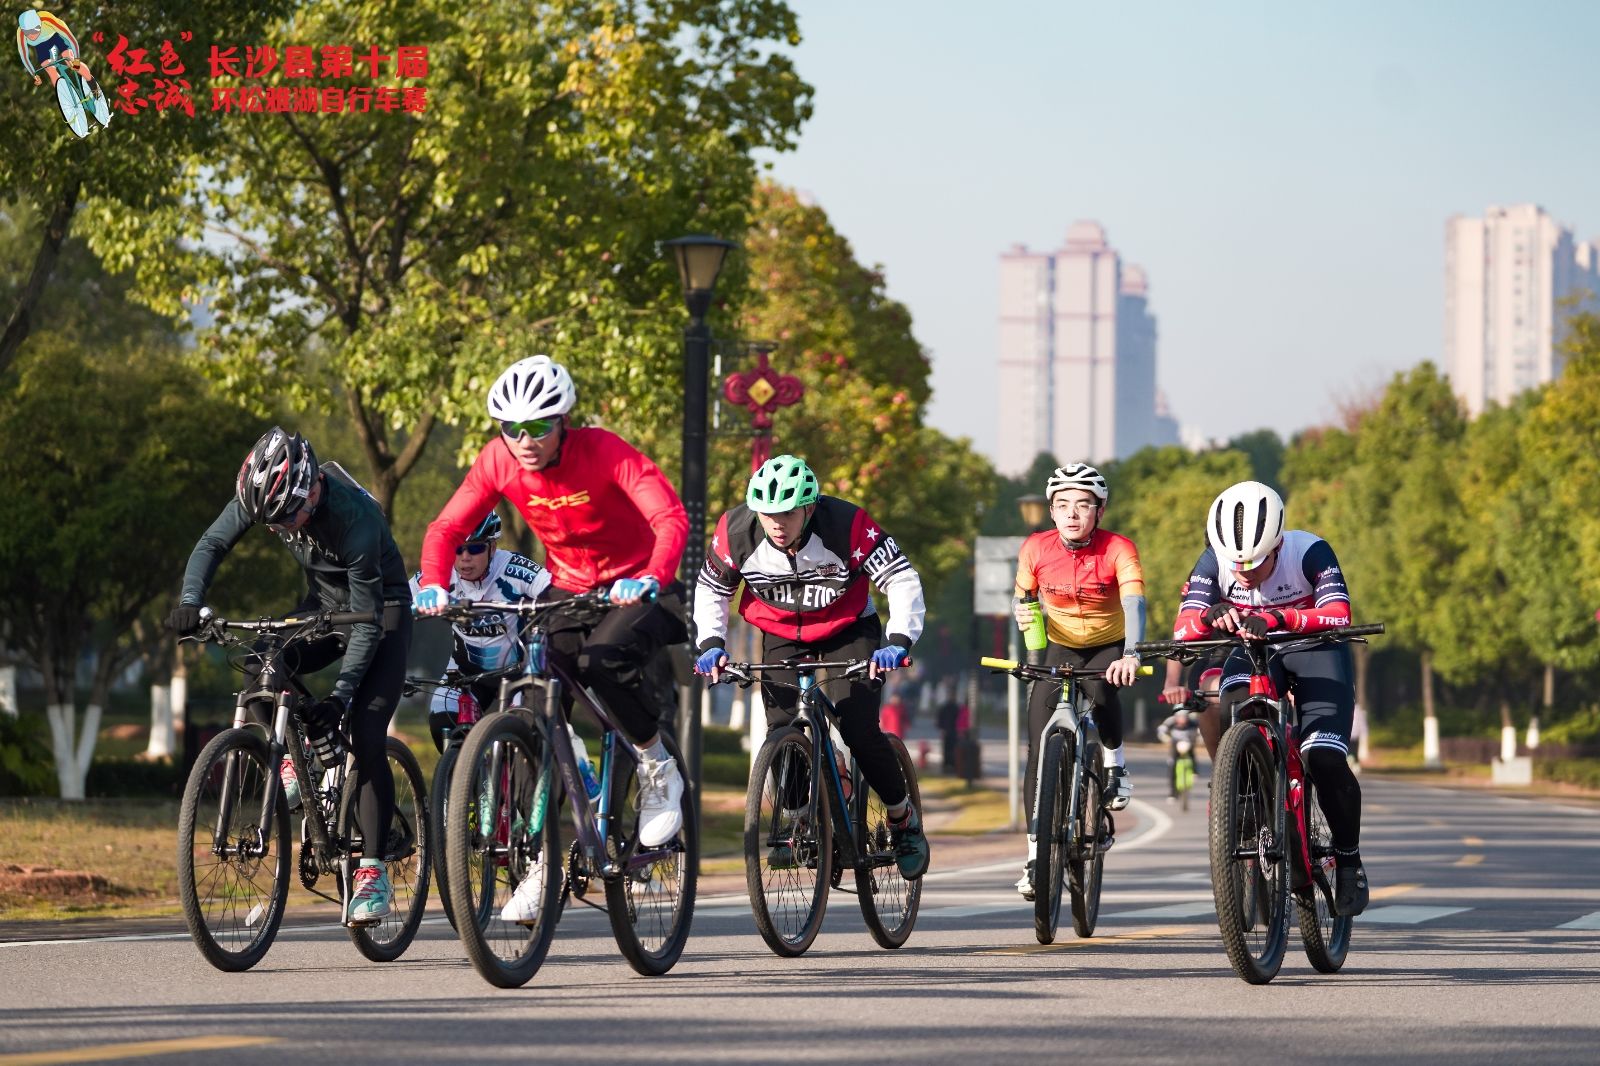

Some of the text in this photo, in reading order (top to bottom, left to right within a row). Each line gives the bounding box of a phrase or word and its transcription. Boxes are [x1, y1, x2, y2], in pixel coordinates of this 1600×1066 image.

[512, 555, 540, 573] BANK
[506, 566, 536, 582] SAXO
[1317, 615, 1350, 626] TREK
